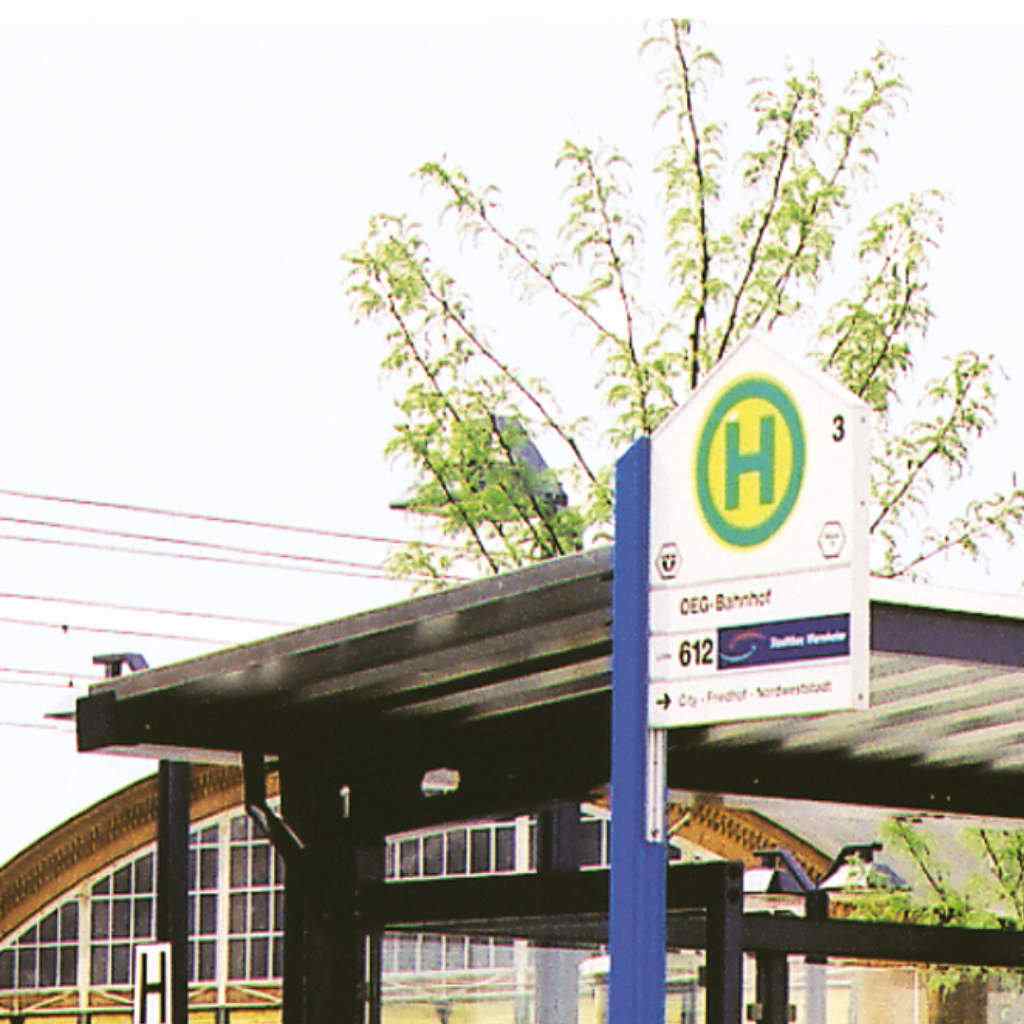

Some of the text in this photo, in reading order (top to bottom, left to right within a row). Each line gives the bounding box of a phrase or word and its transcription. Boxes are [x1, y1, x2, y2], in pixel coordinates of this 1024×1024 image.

[832, 414, 845, 442] 3
[725, 415, 775, 511] H
[679, 638, 713, 667] 612
[139, 951, 167, 1024] H
